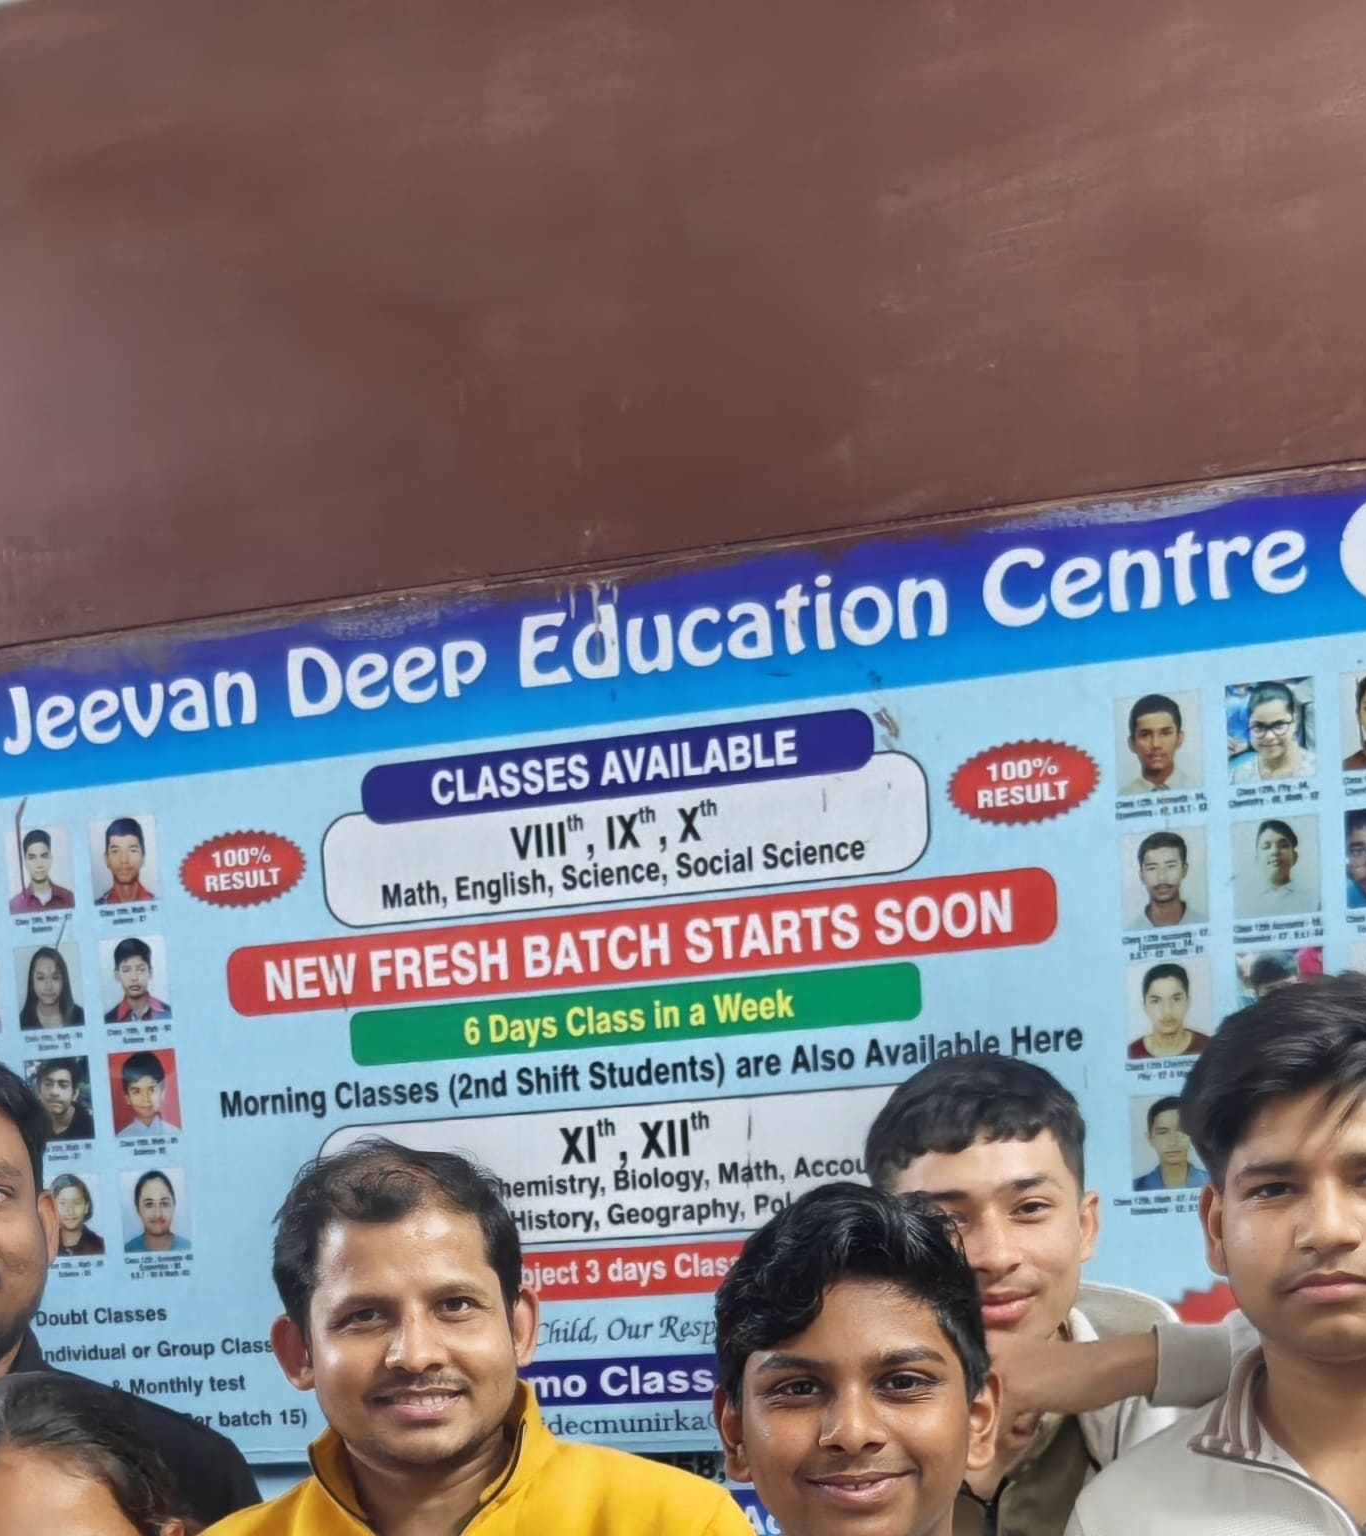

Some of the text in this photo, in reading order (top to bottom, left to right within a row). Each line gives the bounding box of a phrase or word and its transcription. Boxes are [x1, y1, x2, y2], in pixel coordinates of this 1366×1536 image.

[3, 528, 1309, 755] Jeevan Deep Education Centre
[431, 730, 797, 805] CLASSES AVAILABLE
[986, 756, 1059, 782] 100%
[976, 780, 1069, 809] RESULT
[211, 845, 271, 870] 100%
[381, 837, 865, 909] Math, English, Science, Social Science
[204, 866, 281, 894] RESULT
[264, 888, 1013, 1002] NEW FRESH BATCH STARTS SOON
[464, 989, 795, 1048] 6 Days Class in a Week
[220, 1025, 1084, 1118] Morning Classes (2nd Shift Students) are Also Available Here
[498, 1156, 868, 1200] hemistry, Biology, Math, Accou
[511, 1192, 791, 1232] History, Geography, Pol
[522, 1262, 579, 1292] bject
[586, 1261, 600, 1283] 3
[607, 1257, 668, 1288] days
[36, 1307, 167, 1327] Doubt Classes
[607, 1317, 654, 1341] Our
[42, 1337, 274, 1363] ndividual or Group Class
[129, 1376, 204, 1396] Monthly
[209, 1374, 246, 1392] test
[528, 1365, 715, 1398] mo Class
[219, 1410, 272, 1428] batch
[278, 1408, 308, 1428] 15)
